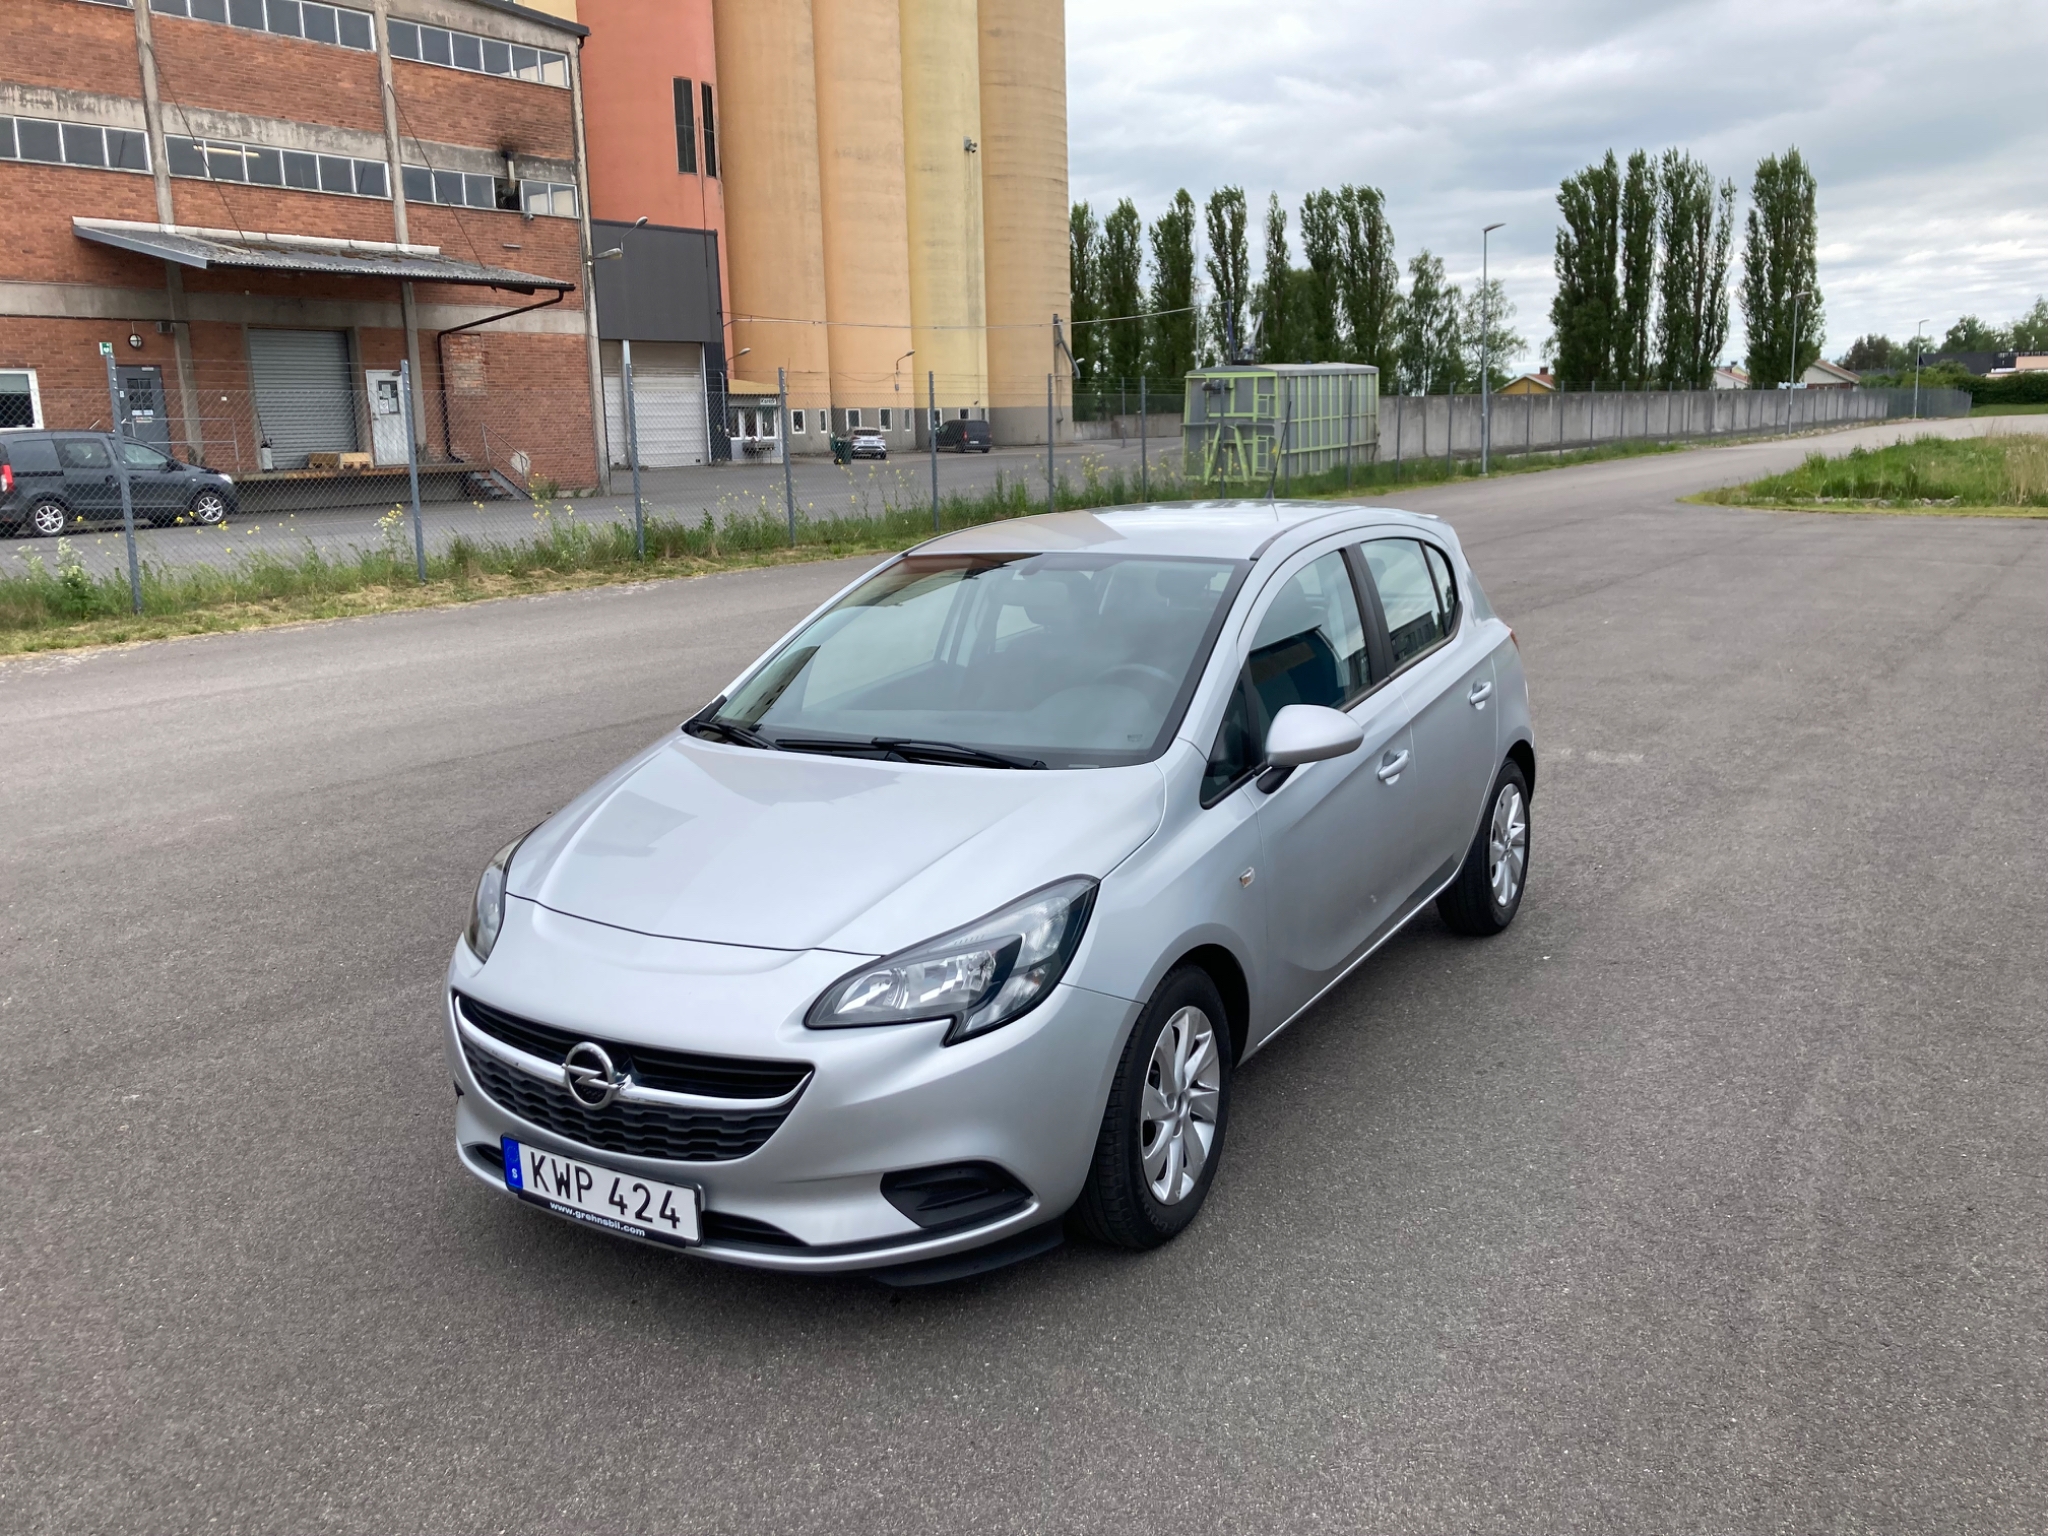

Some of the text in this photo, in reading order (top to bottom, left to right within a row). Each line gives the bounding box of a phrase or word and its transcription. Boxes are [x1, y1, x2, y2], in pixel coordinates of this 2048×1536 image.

[511, 1168, 518, 1179] S
[530, 1151, 681, 1229] KWP 424
[549, 1202, 646, 1237] www.grehnsbil.com
